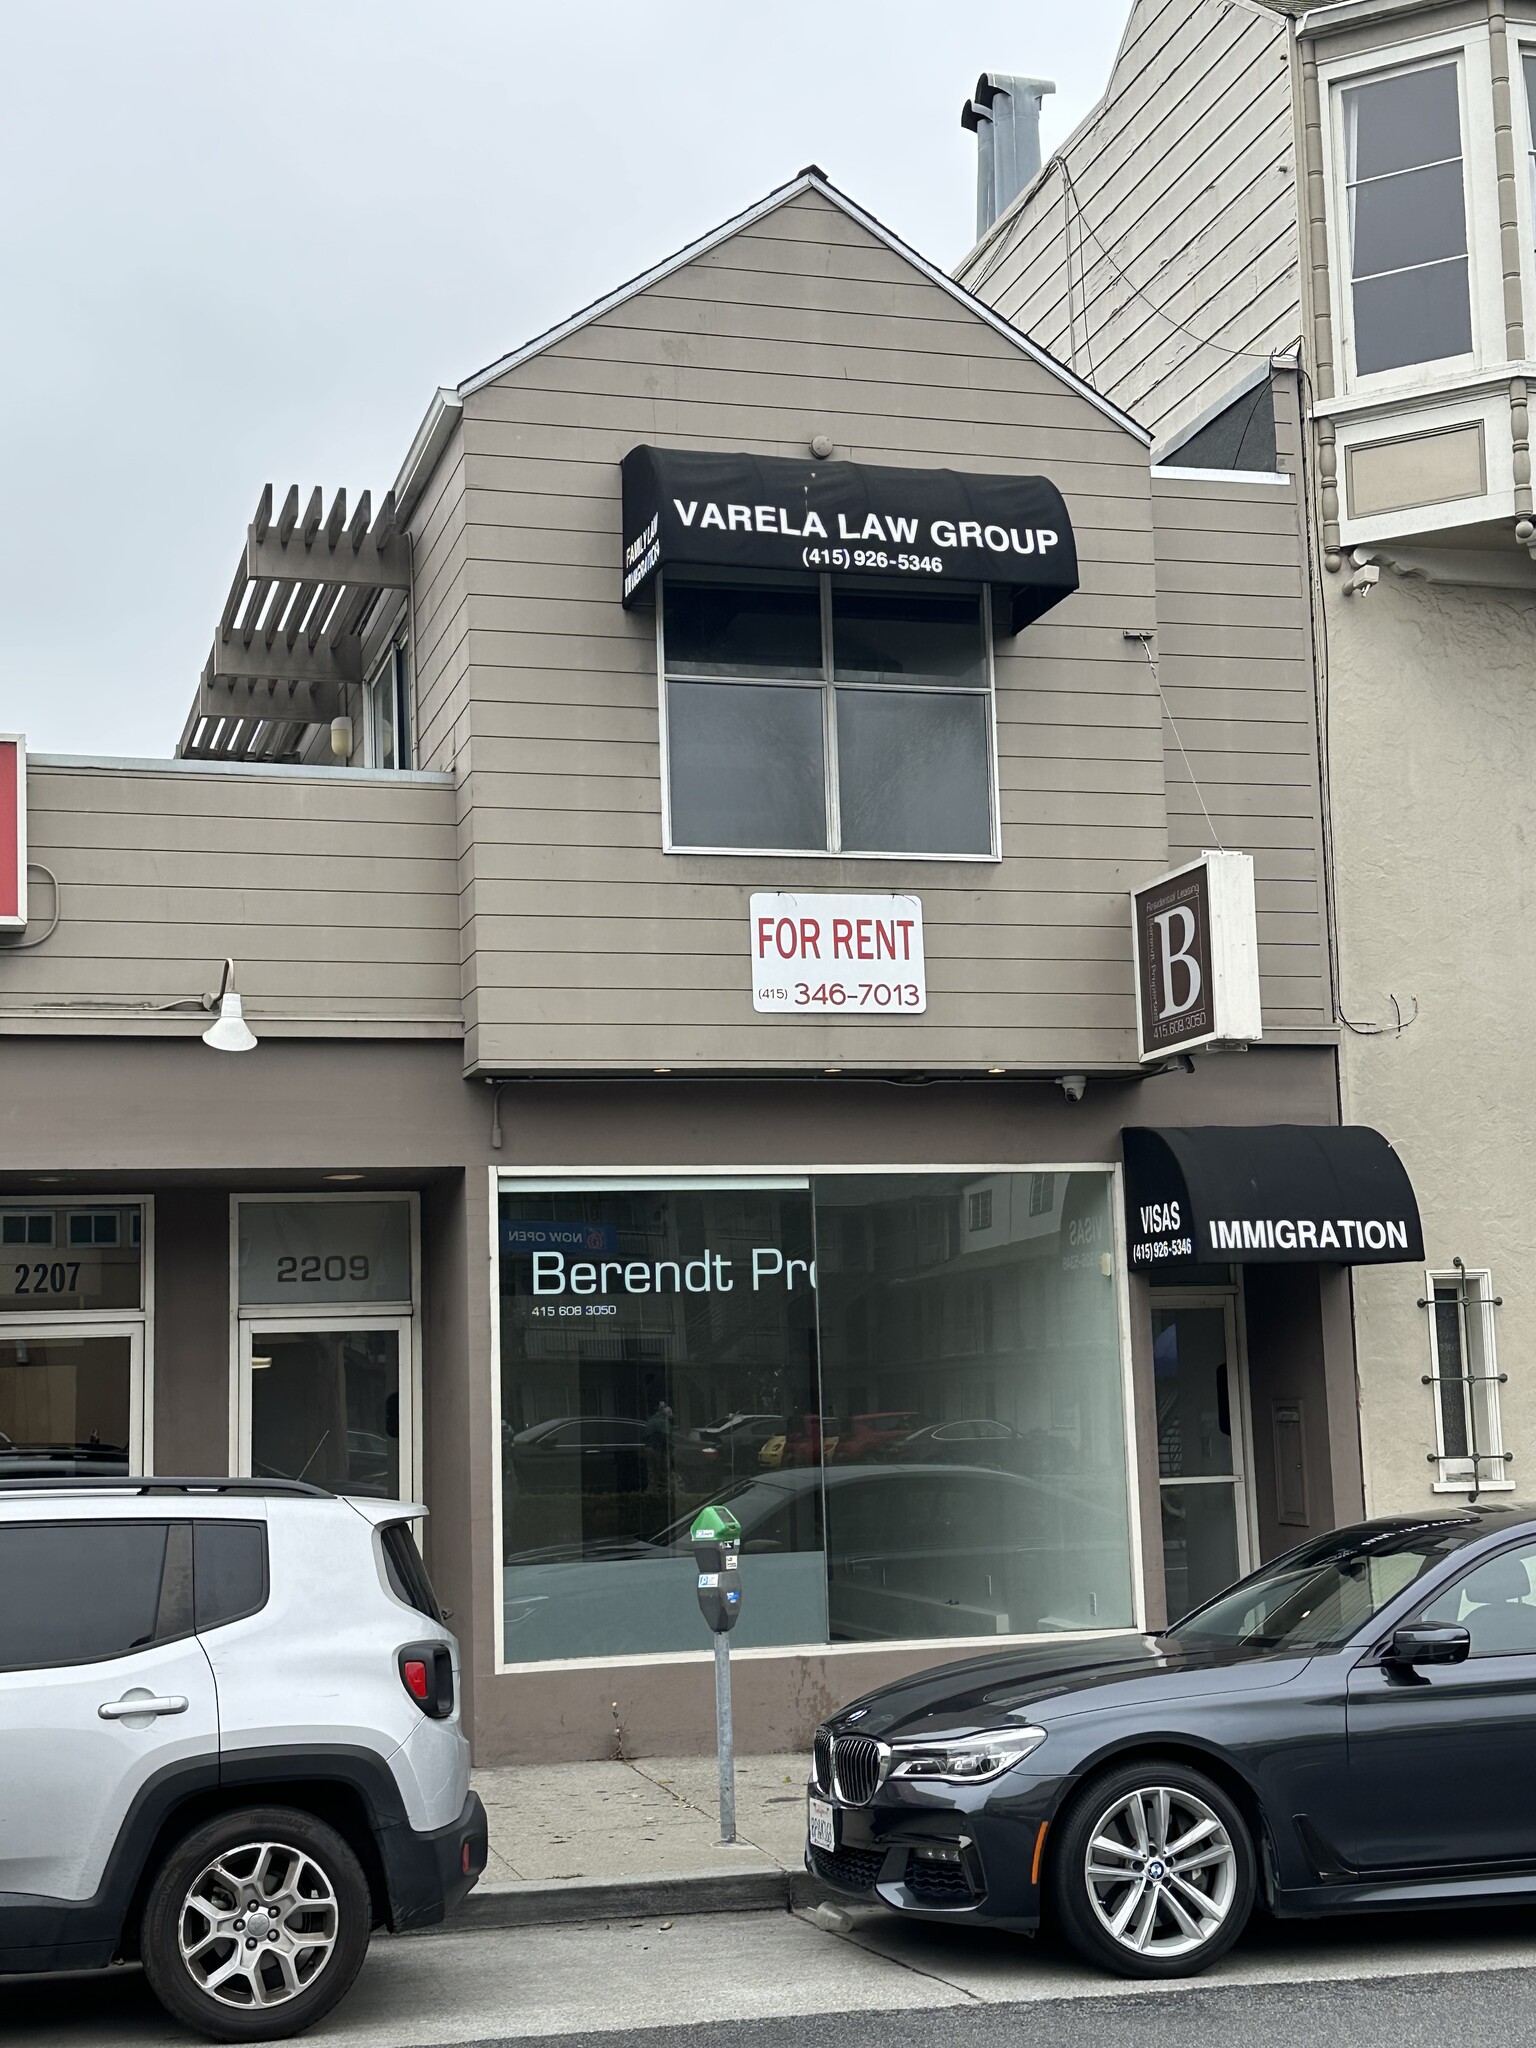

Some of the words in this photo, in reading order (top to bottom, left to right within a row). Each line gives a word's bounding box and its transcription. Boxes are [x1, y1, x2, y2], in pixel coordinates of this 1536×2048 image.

[673, 499, 828, 538] VARELA
[838, 513, 918, 544] LAW
[931, 521, 1059, 554] GROUP
[626, 529, 648, 568] FAMILY
[802, 547, 850, 569] (415)
[854, 549, 943, 573] 926-5346
[758, 917, 821, 959] FOR
[832, 918, 914, 960] RENT
[1154, 905, 1201, 1019] B
[758, 988, 788, 1000] (415)
[794, 982, 919, 1006] 346-7013
[1140, 1201, 1180, 1234] VISAS
[1133, 1242, 1153, 1263] (415)
[1153, 1237, 1192, 1258] 926-5346
[1209, 1220, 1408, 1249] IMMIGRATION
[15, 1262, 81, 1294] 2207
[277, 1255, 369, 1283] 2209
[532, 1249, 734, 1295] Berendt
[752, 1248, 817, 1291] Pr
[531, 1306, 555, 1317] 415
[558, 1306, 582, 1316] 608
[585, 1305, 617, 1316] 3050
